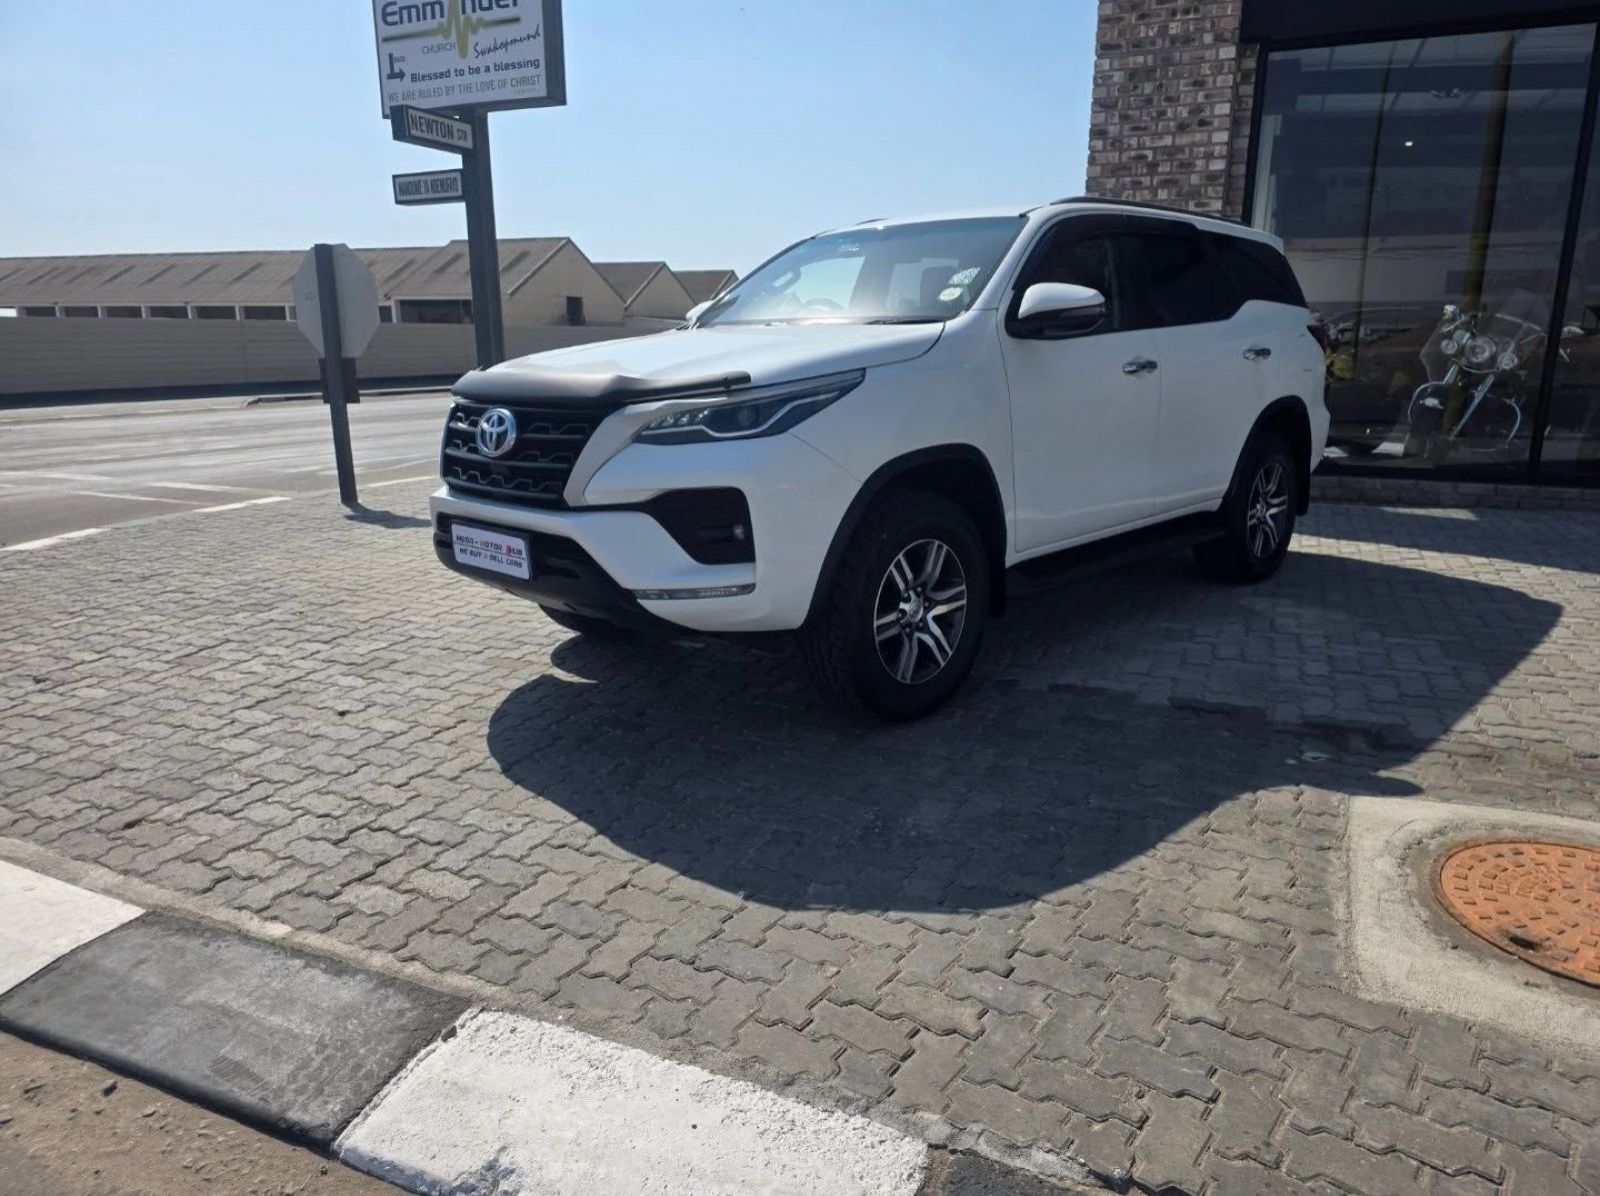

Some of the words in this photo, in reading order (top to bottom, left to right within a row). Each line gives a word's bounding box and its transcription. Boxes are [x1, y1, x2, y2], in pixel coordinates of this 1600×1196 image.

[421, 41, 456, 55] CHURCH
[410, 66, 451, 83] Blessed
[454, 65, 465, 78] to
[468, 62, 481, 76] be
[484, 62, 491, 73] a
[493, 58, 541, 74] blessing
[388, 92, 400, 104] WE
[401, 90, 417, 102] ARE
[418, 86, 444, 99] RULED
[445, 85, 456, 96] BY
[458, 83, 473, 94] THE
[475, 80, 496, 93] LOVE
[498, 78, 509, 89] OF
[510, 74, 542, 88] CHRIST
[410, 112, 454, 140] NEWTON
